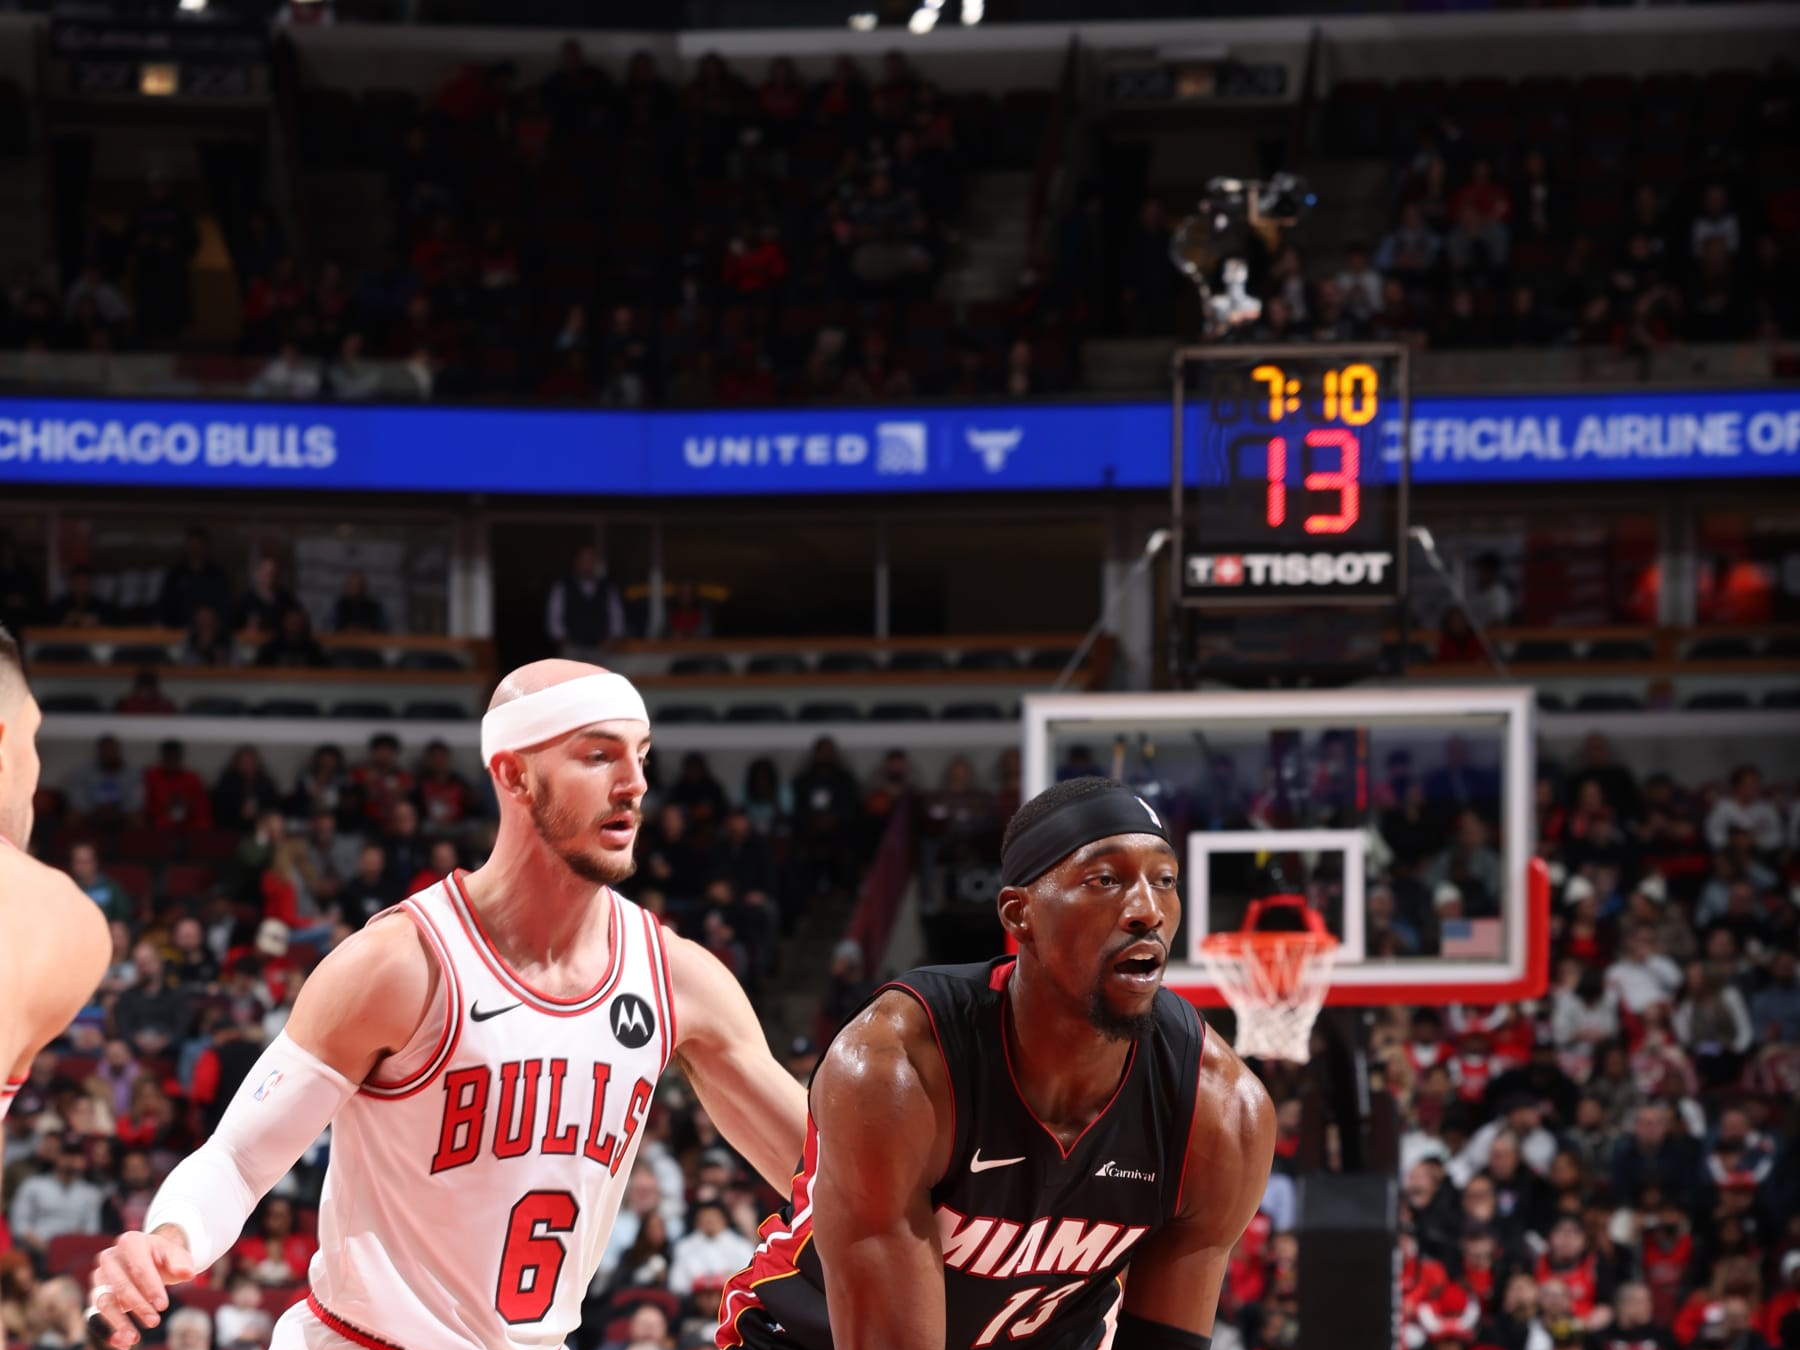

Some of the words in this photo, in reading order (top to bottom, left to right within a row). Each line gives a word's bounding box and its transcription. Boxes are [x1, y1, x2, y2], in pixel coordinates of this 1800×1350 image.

[1252, 363, 1379, 426] 7:10
[204, 421, 338, 468] BULLS
[683, 433, 869, 468] UNITED
[1572, 409, 1742, 459] AIRLINE
[1266, 428, 1360, 534] 13
[1244, 552, 1393, 585] TISSOT
[430, 1058, 654, 1178] BULLS
[1108, 1167, 1156, 1183] Carnival
[495, 1190, 580, 1325] 6
[934, 1203, 1150, 1279] MIAMI
[970, 1276, 1088, 1350] 13
